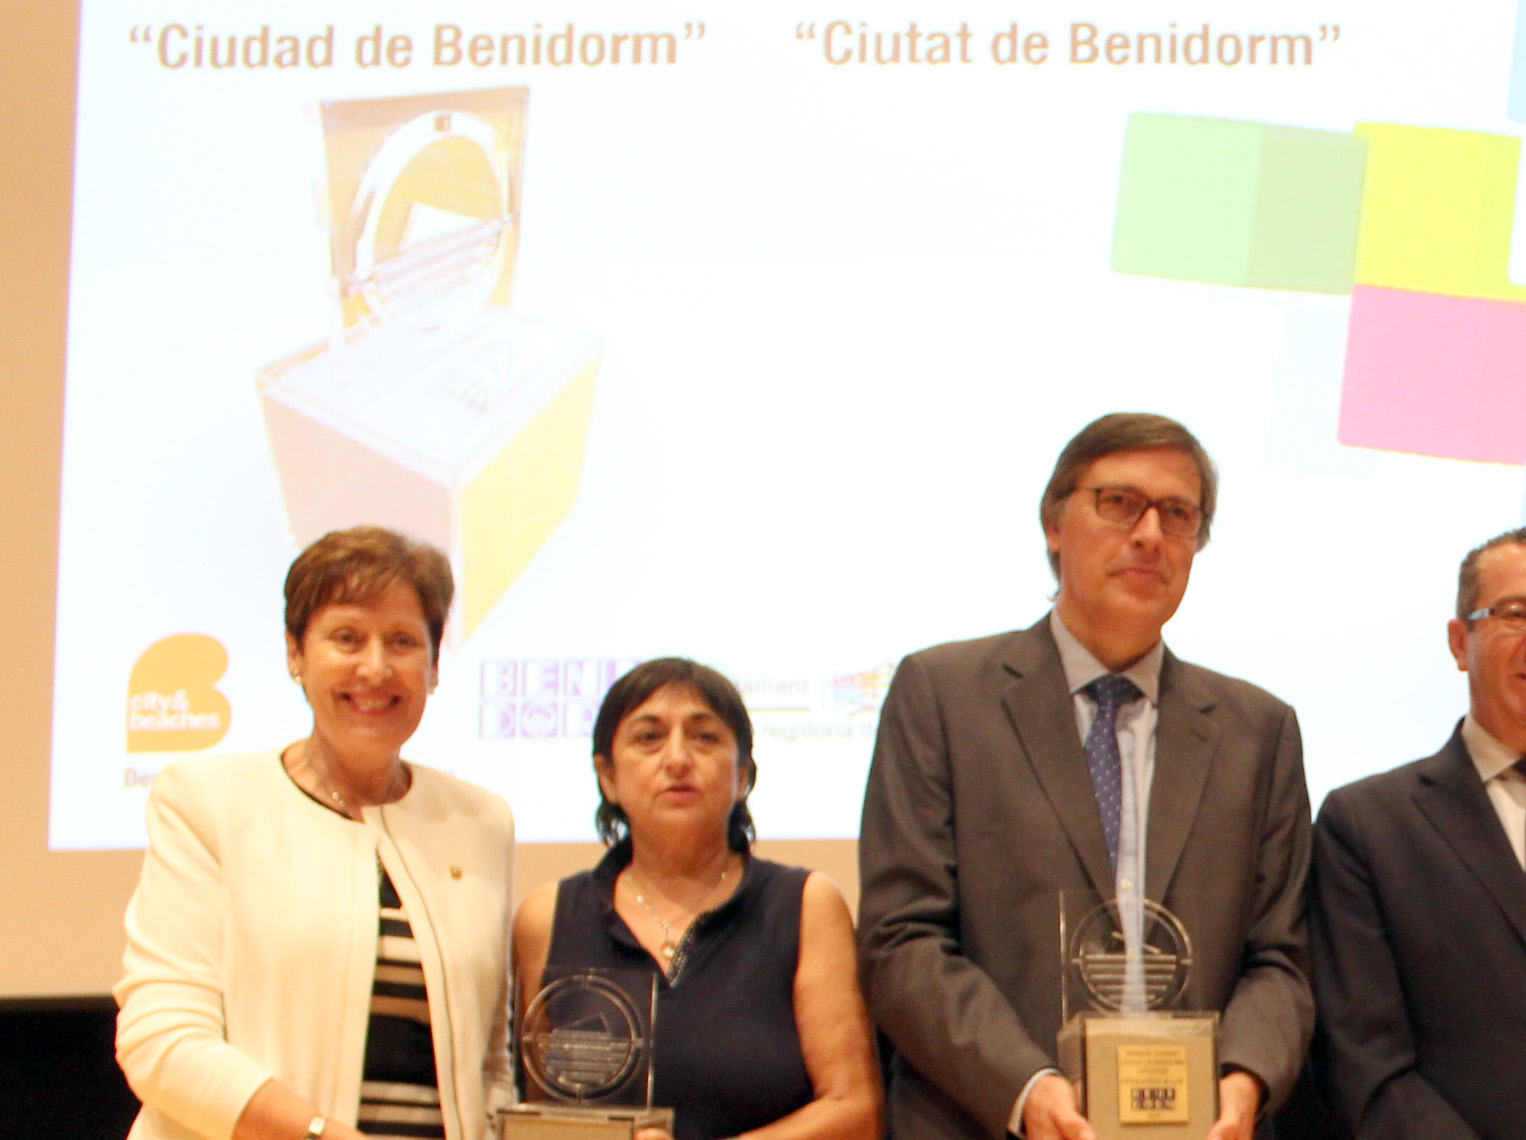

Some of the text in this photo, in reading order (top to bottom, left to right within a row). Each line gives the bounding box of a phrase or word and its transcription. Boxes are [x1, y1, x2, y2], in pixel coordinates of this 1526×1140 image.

[128, 23, 706, 68] “Ciudad de Benidorm”
[794, 21, 1341, 65] “Ciutat de Benidorm”
[480, 701, 600, 738] DOR
